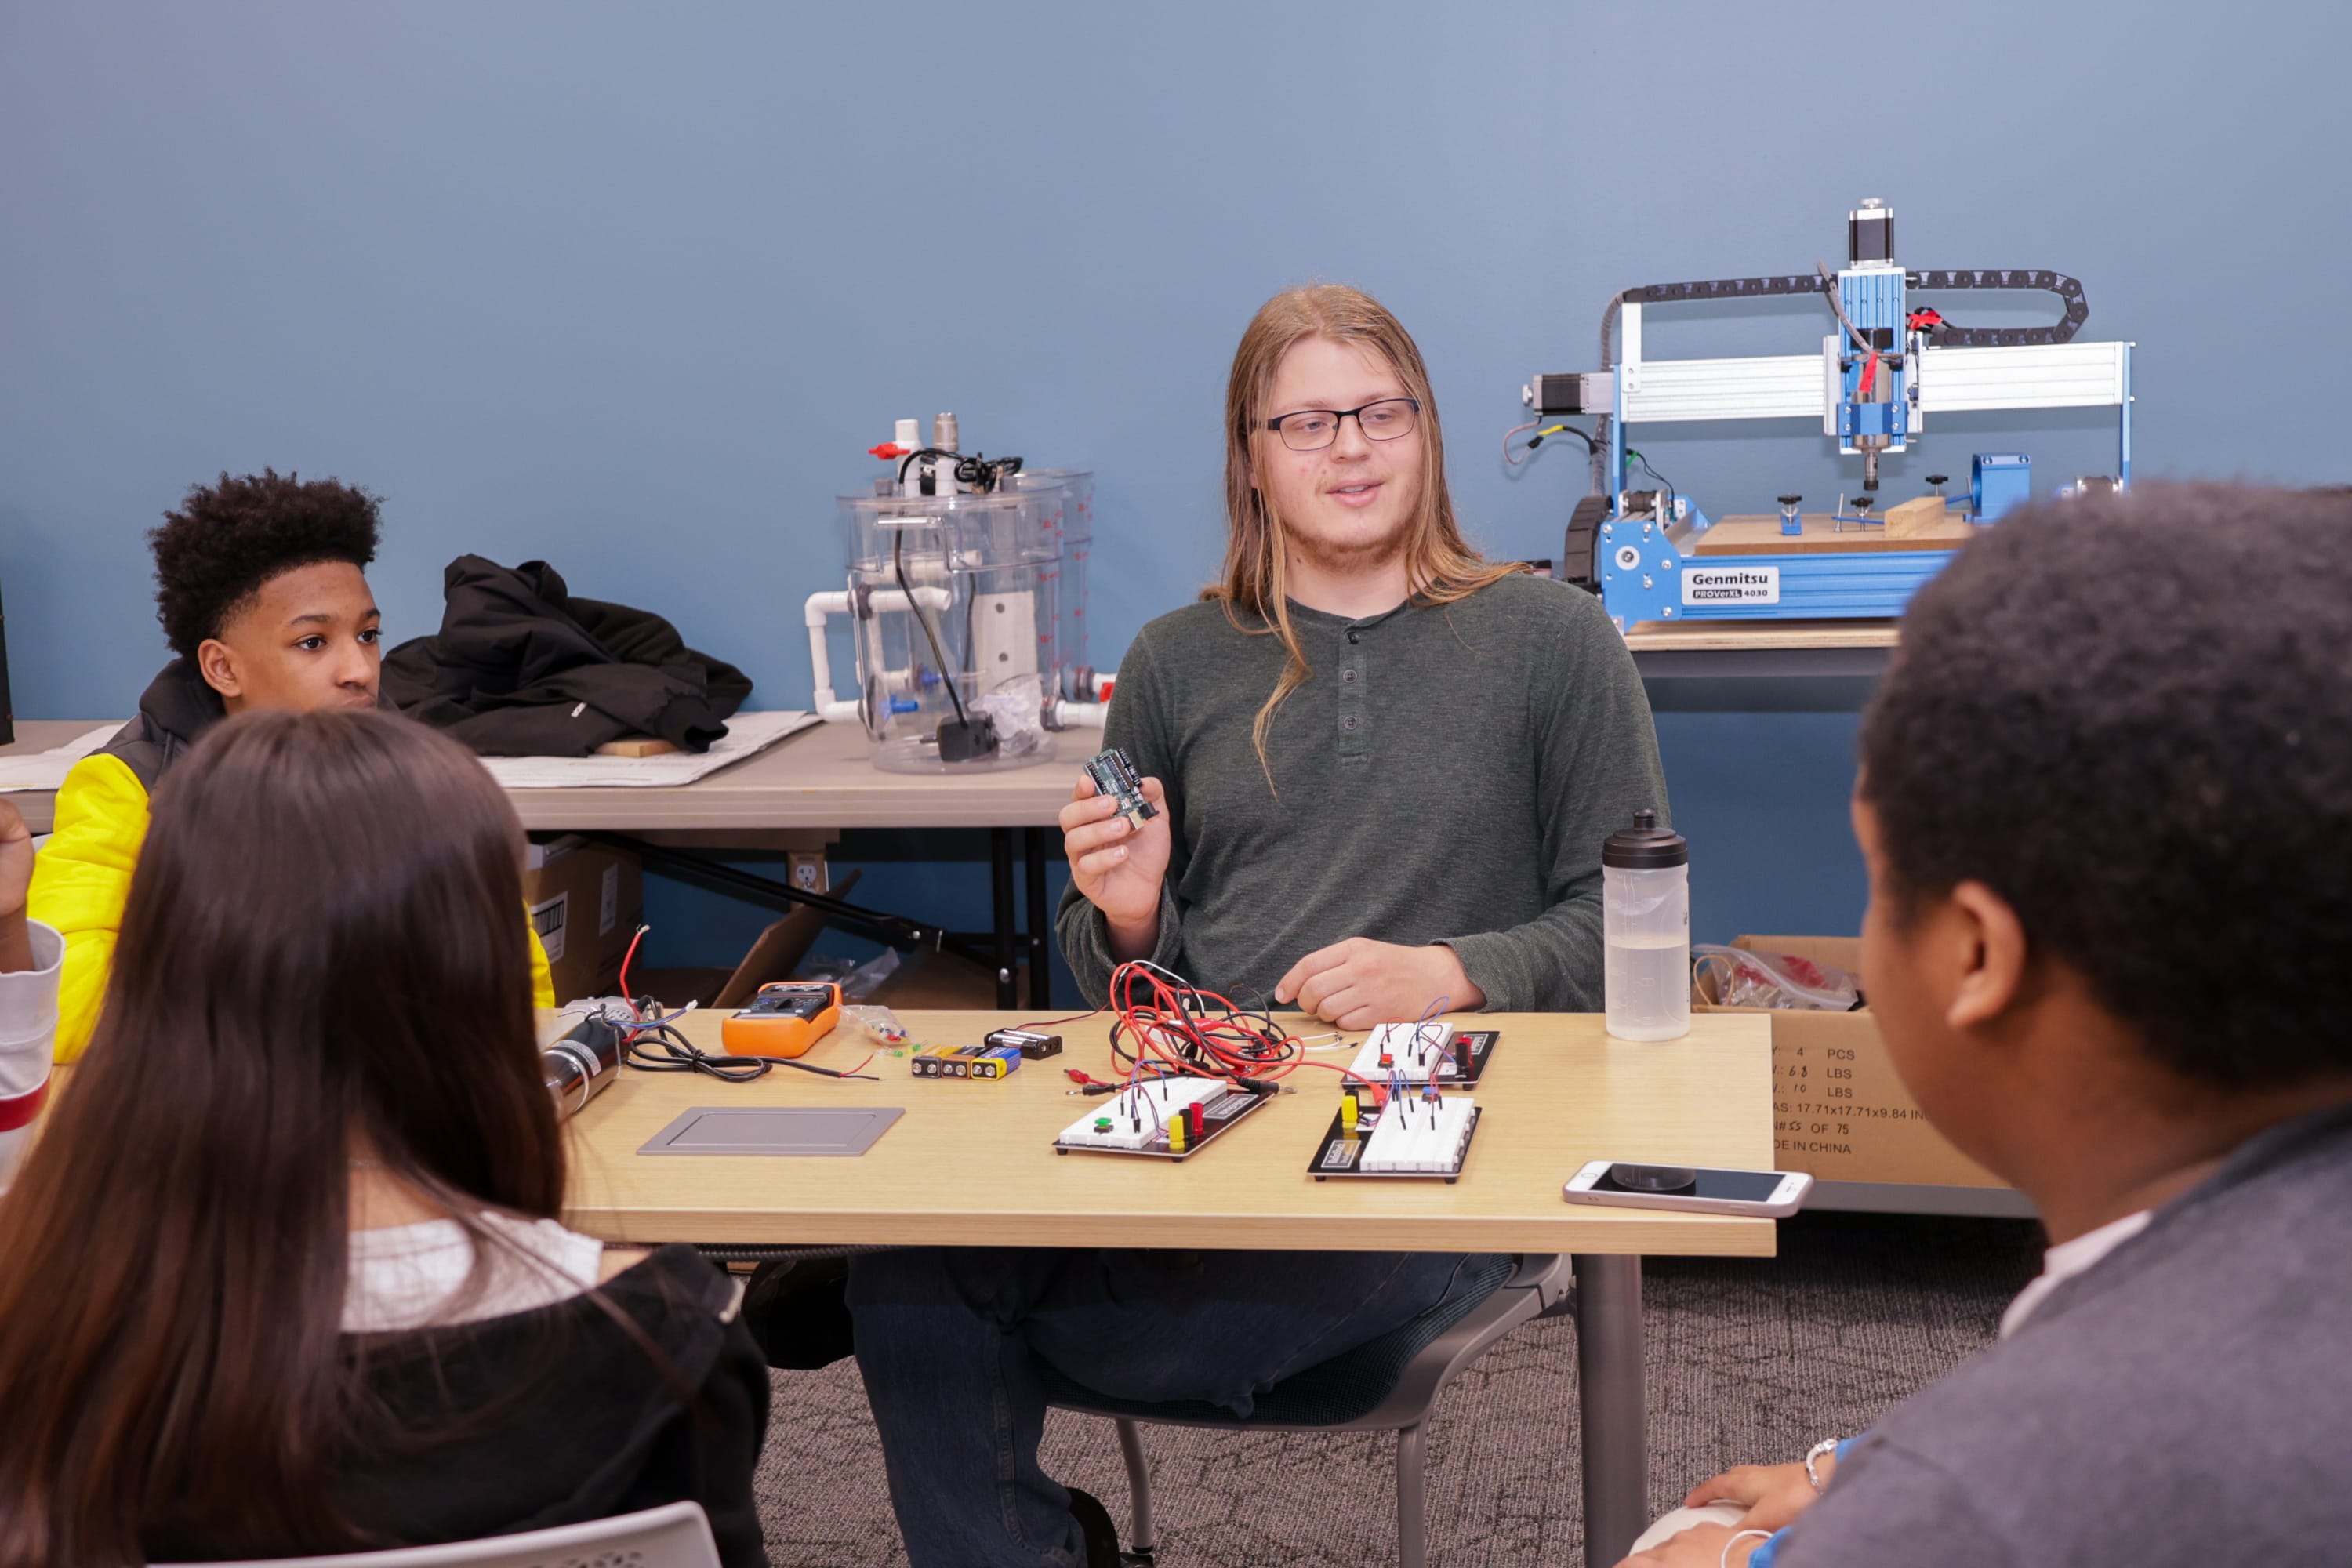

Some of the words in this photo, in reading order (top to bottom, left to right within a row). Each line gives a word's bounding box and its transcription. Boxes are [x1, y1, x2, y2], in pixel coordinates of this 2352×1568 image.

[1693, 573, 1769, 585] Genmitsu
[1797, 1047, 1804, 1057] 4
[1827, 1048, 1855, 1061] PCS
[1827, 1068, 1852, 1080] LBS
[1794, 1083, 1807, 1093] 10
[1827, 1087, 1853, 1098] LBS
[1797, 1103, 1907, 1119] 17.71x17.71x9.84
[1810, 1123, 1829, 1134] OF
[1837, 1123, 1849, 1135] 75
[1793, 1141, 1806, 1151] IN
[1809, 1142, 1851, 1154] CHINA
